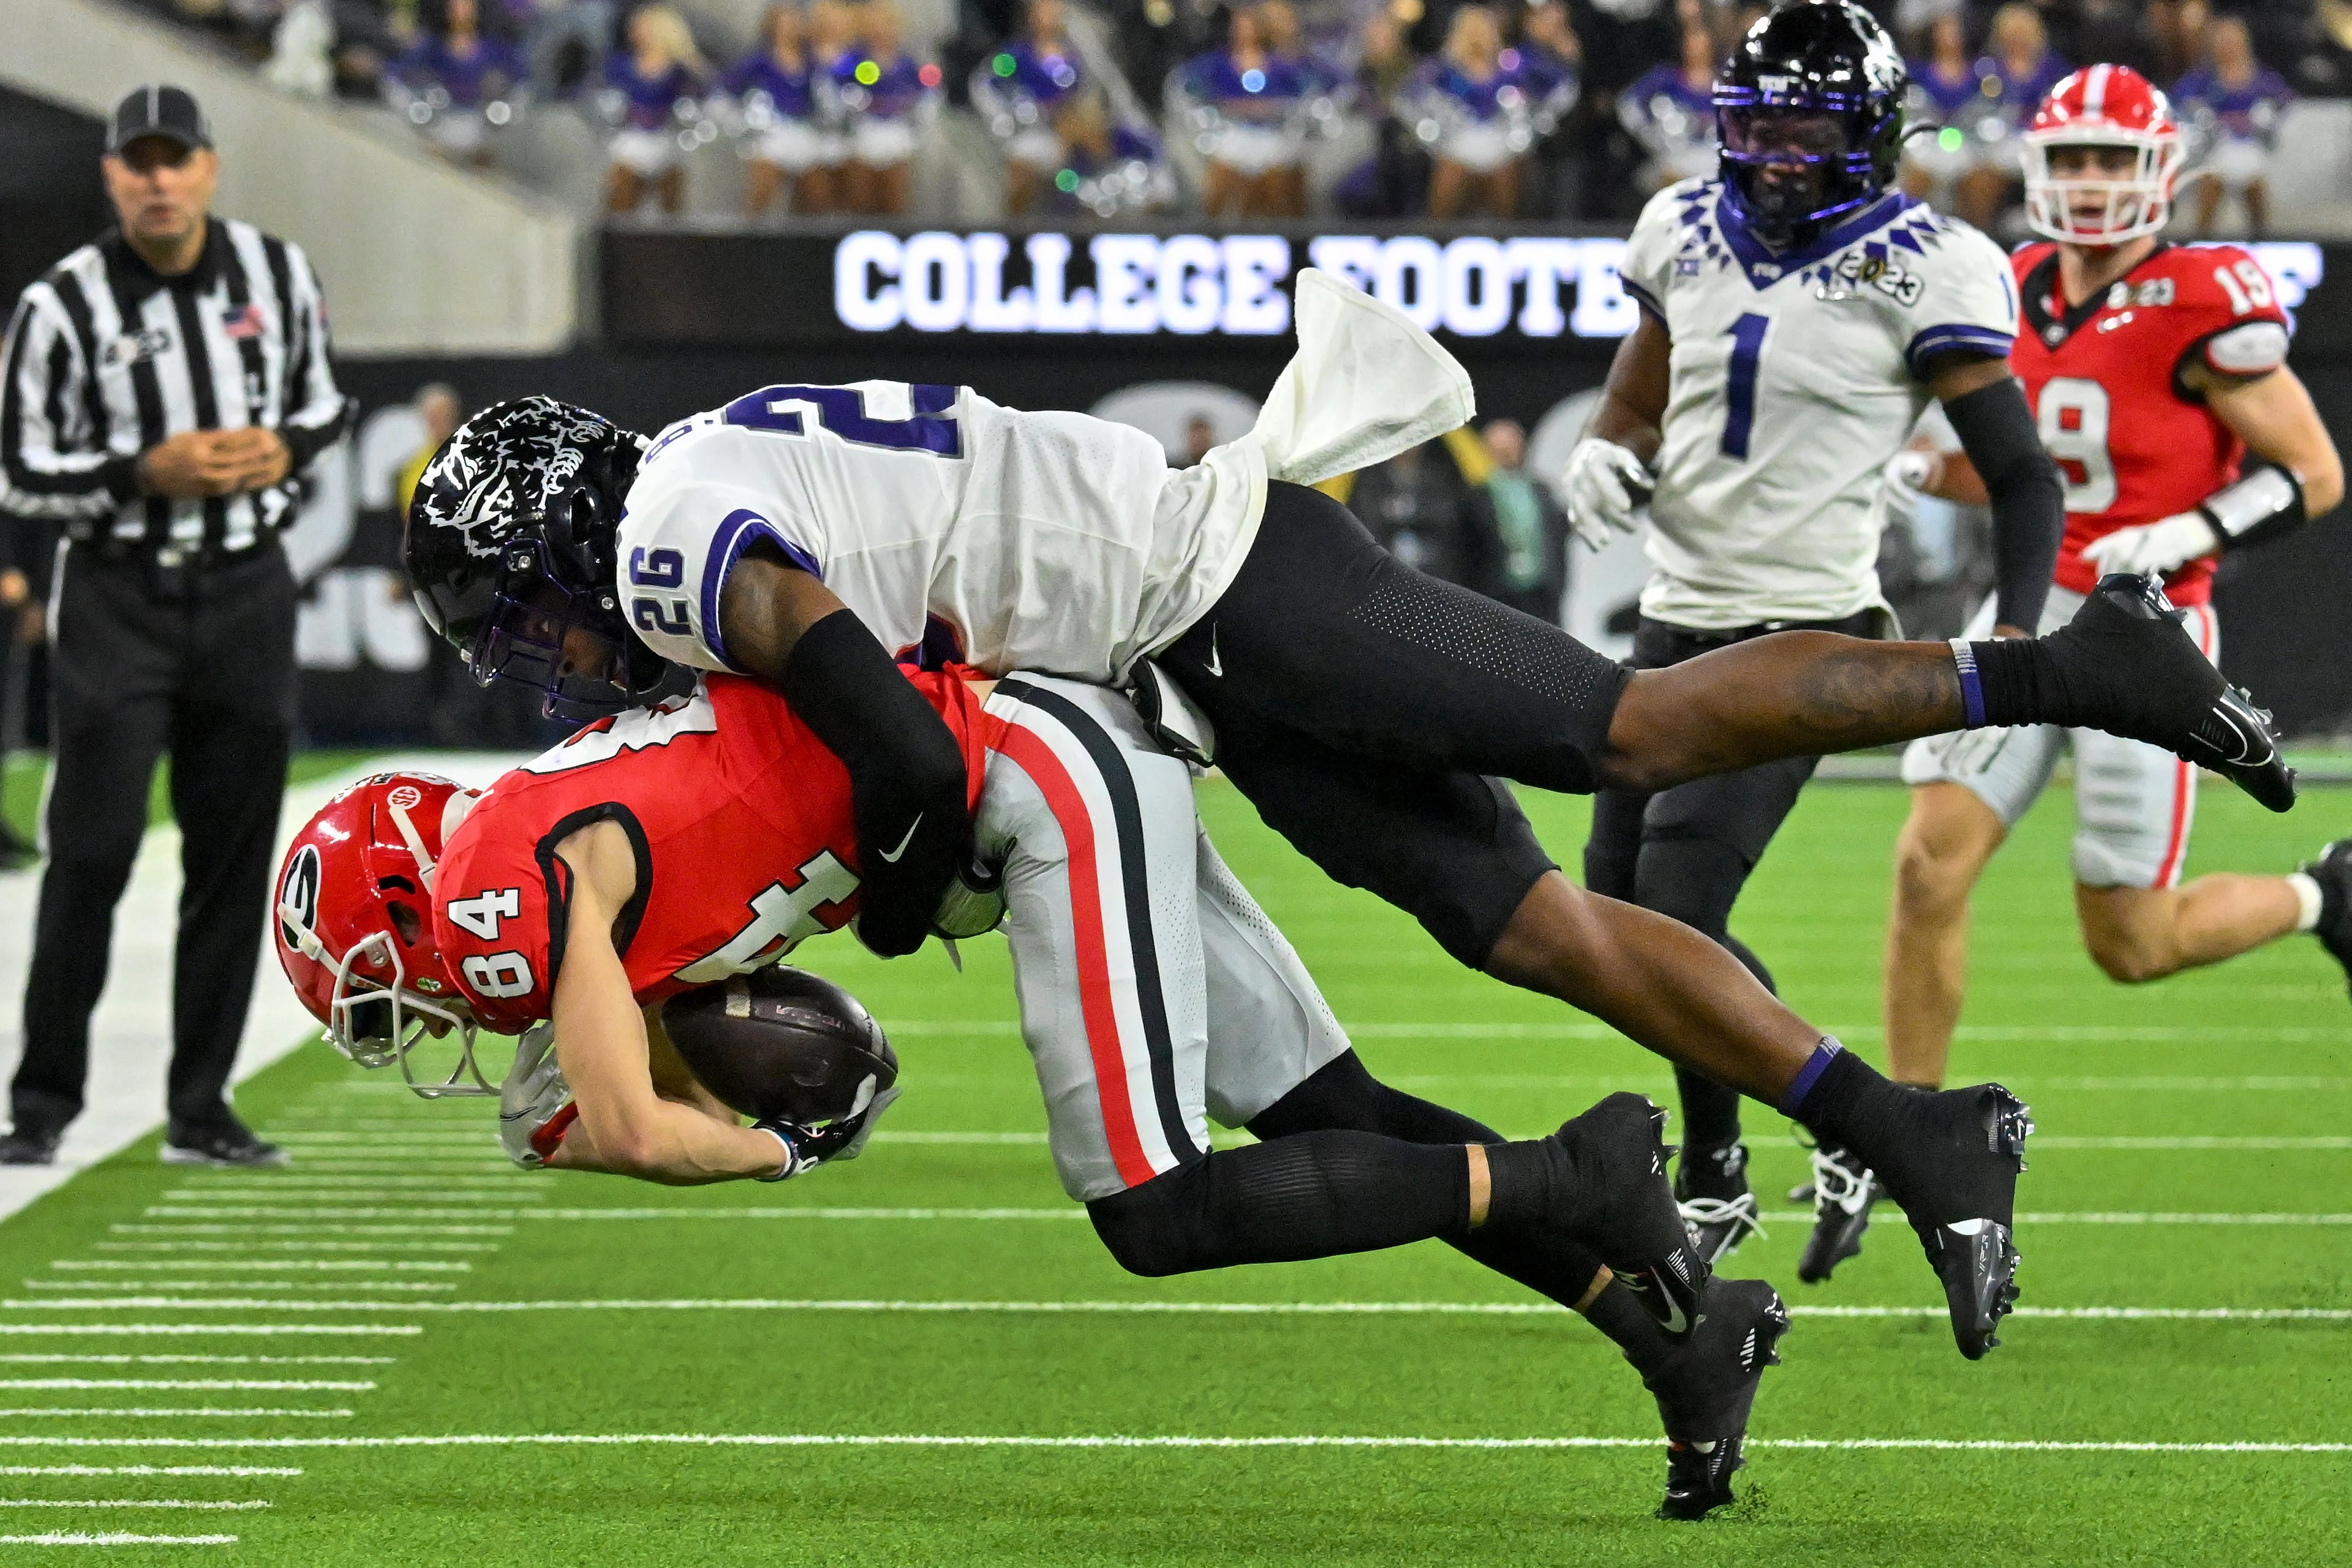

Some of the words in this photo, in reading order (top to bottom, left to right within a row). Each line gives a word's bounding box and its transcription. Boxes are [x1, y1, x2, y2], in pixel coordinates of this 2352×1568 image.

[835, 230, 1290, 334] COLLEGE
[1837, 250, 1925, 307] 2023
[2213, 259, 2272, 317] 19
[1719, 312, 1770, 461] 1
[2016, 376, 2118, 514] 9
[628, 544, 695, 637] 26
[447, 887, 535, 998] 84
